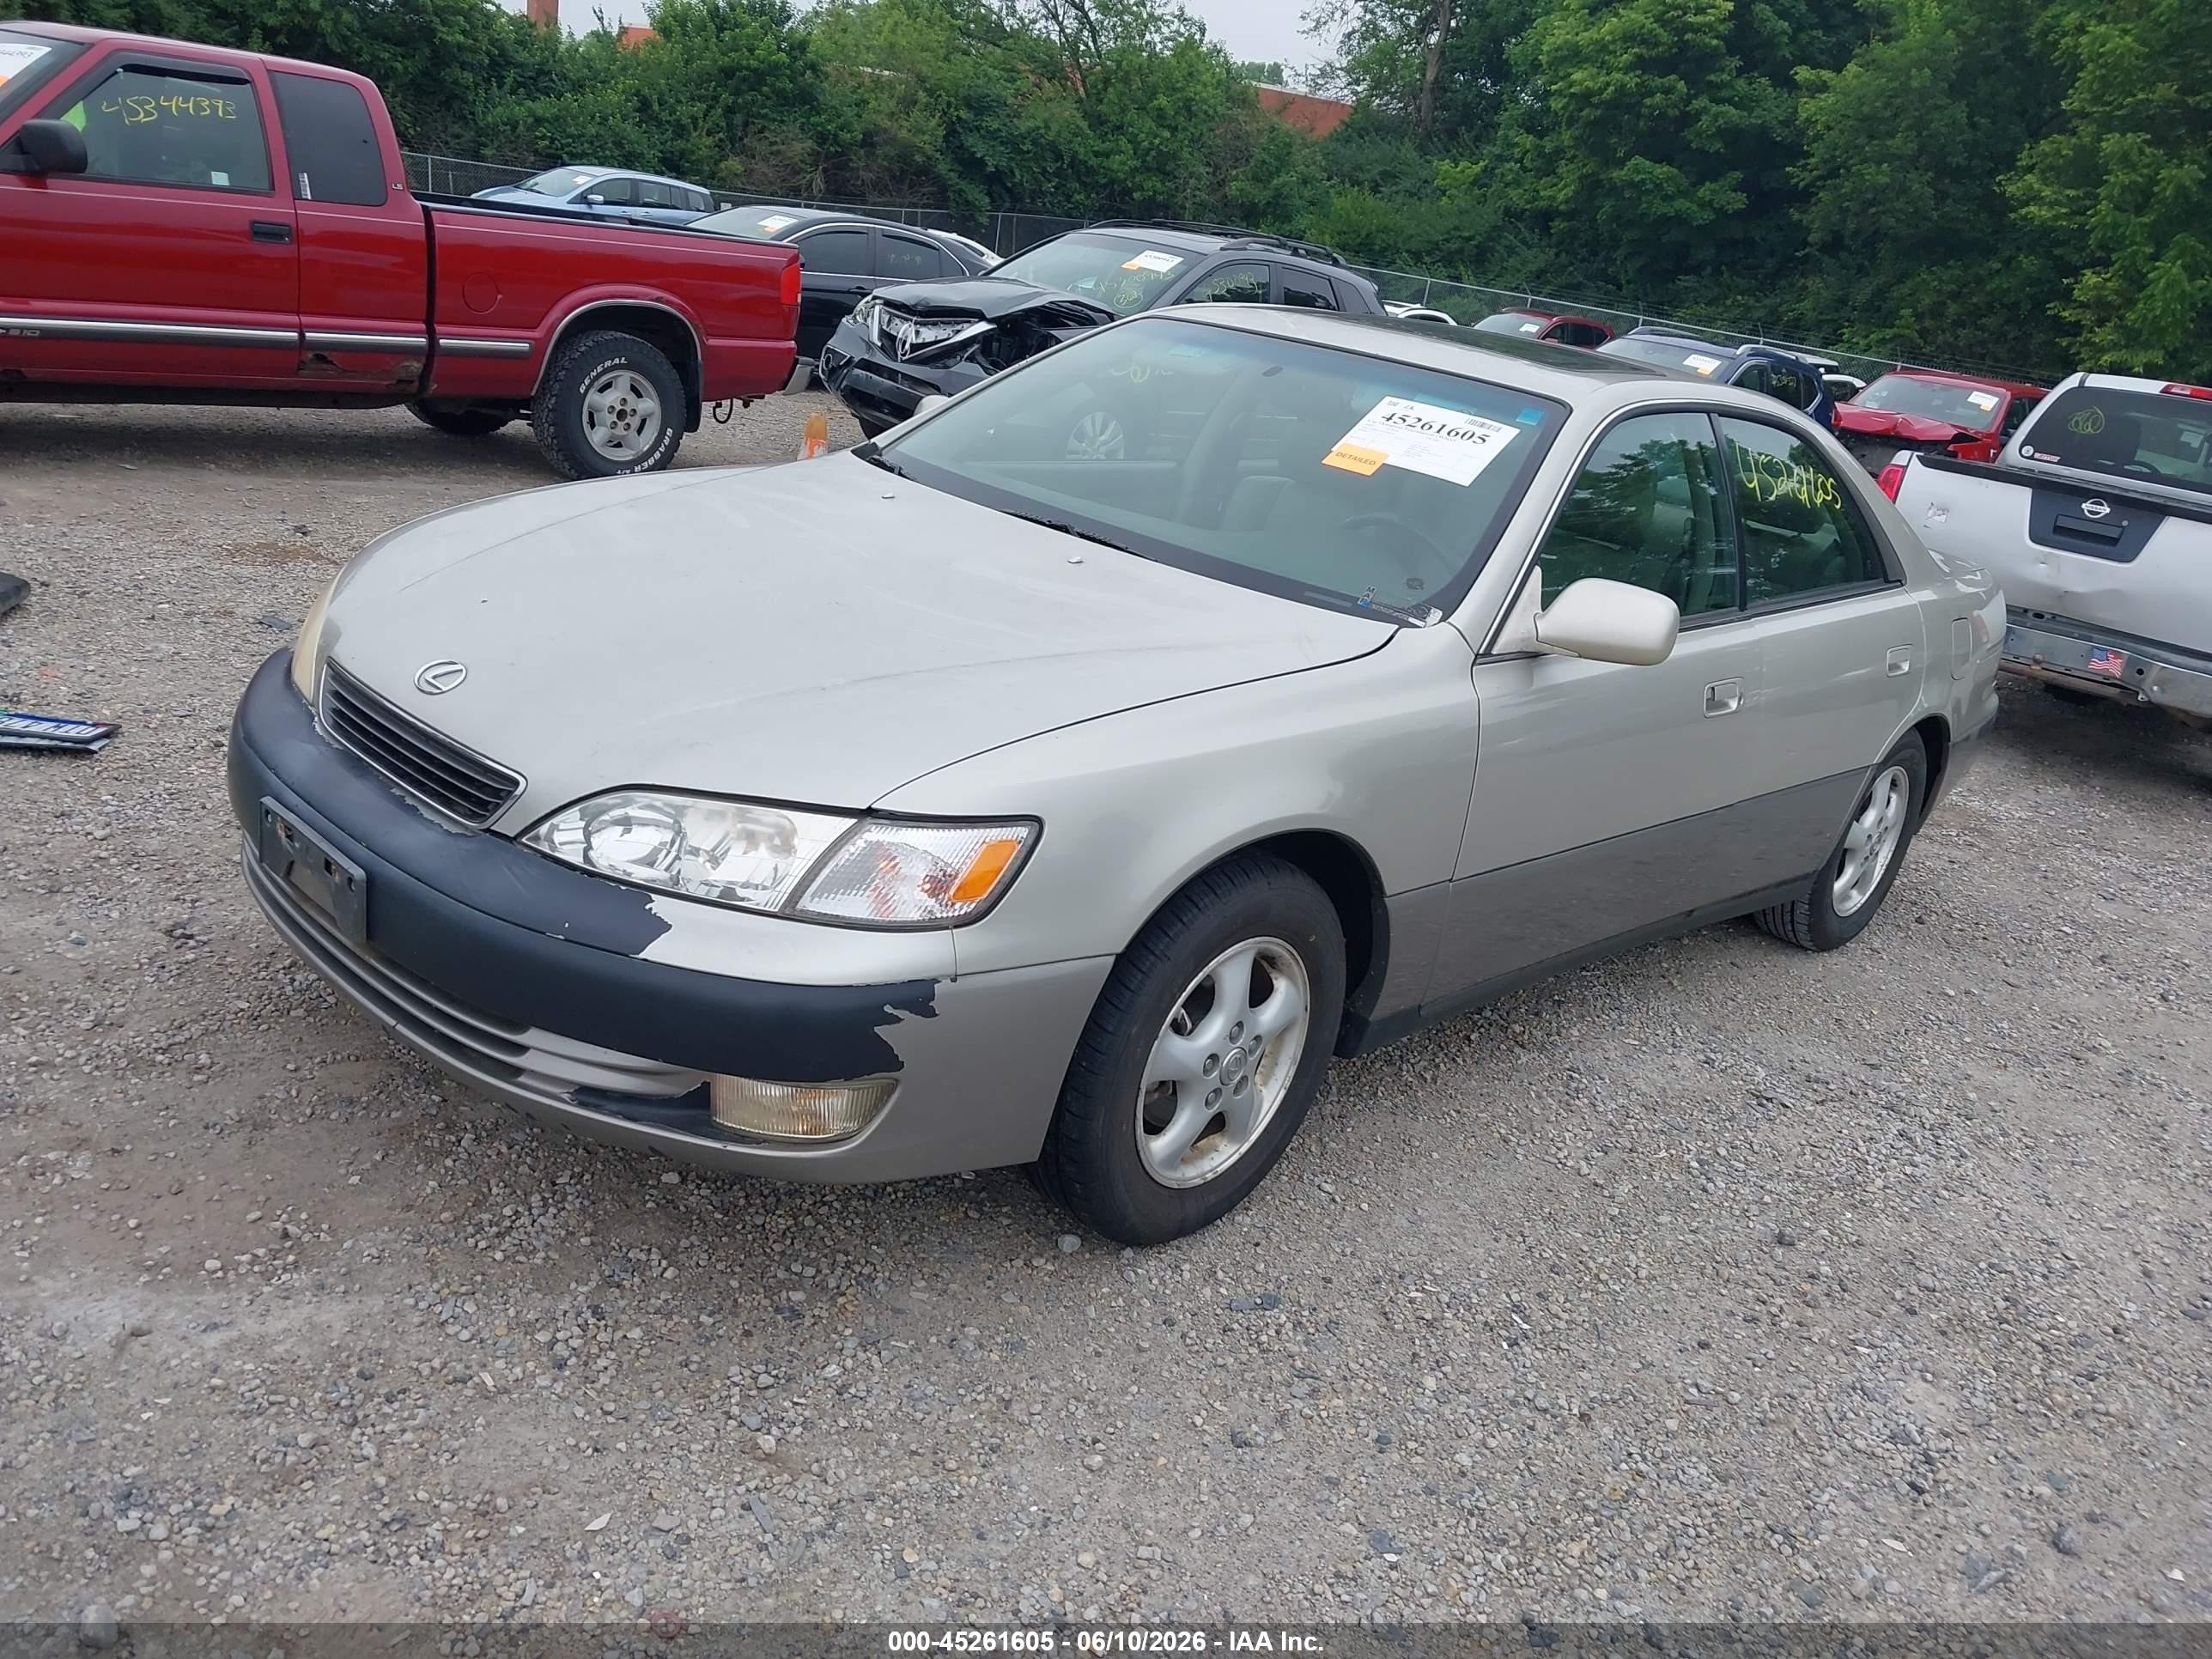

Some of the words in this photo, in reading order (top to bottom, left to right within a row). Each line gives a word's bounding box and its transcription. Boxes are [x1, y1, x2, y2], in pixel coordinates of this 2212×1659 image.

[101, 96, 237, 125] 45344393
[579, 356, 629, 394] GENERAL
[1381, 412, 1492, 445] 45261605
[634, 427, 673, 474] GRABBER
[1335, 452, 1376, 465] DETAILED
